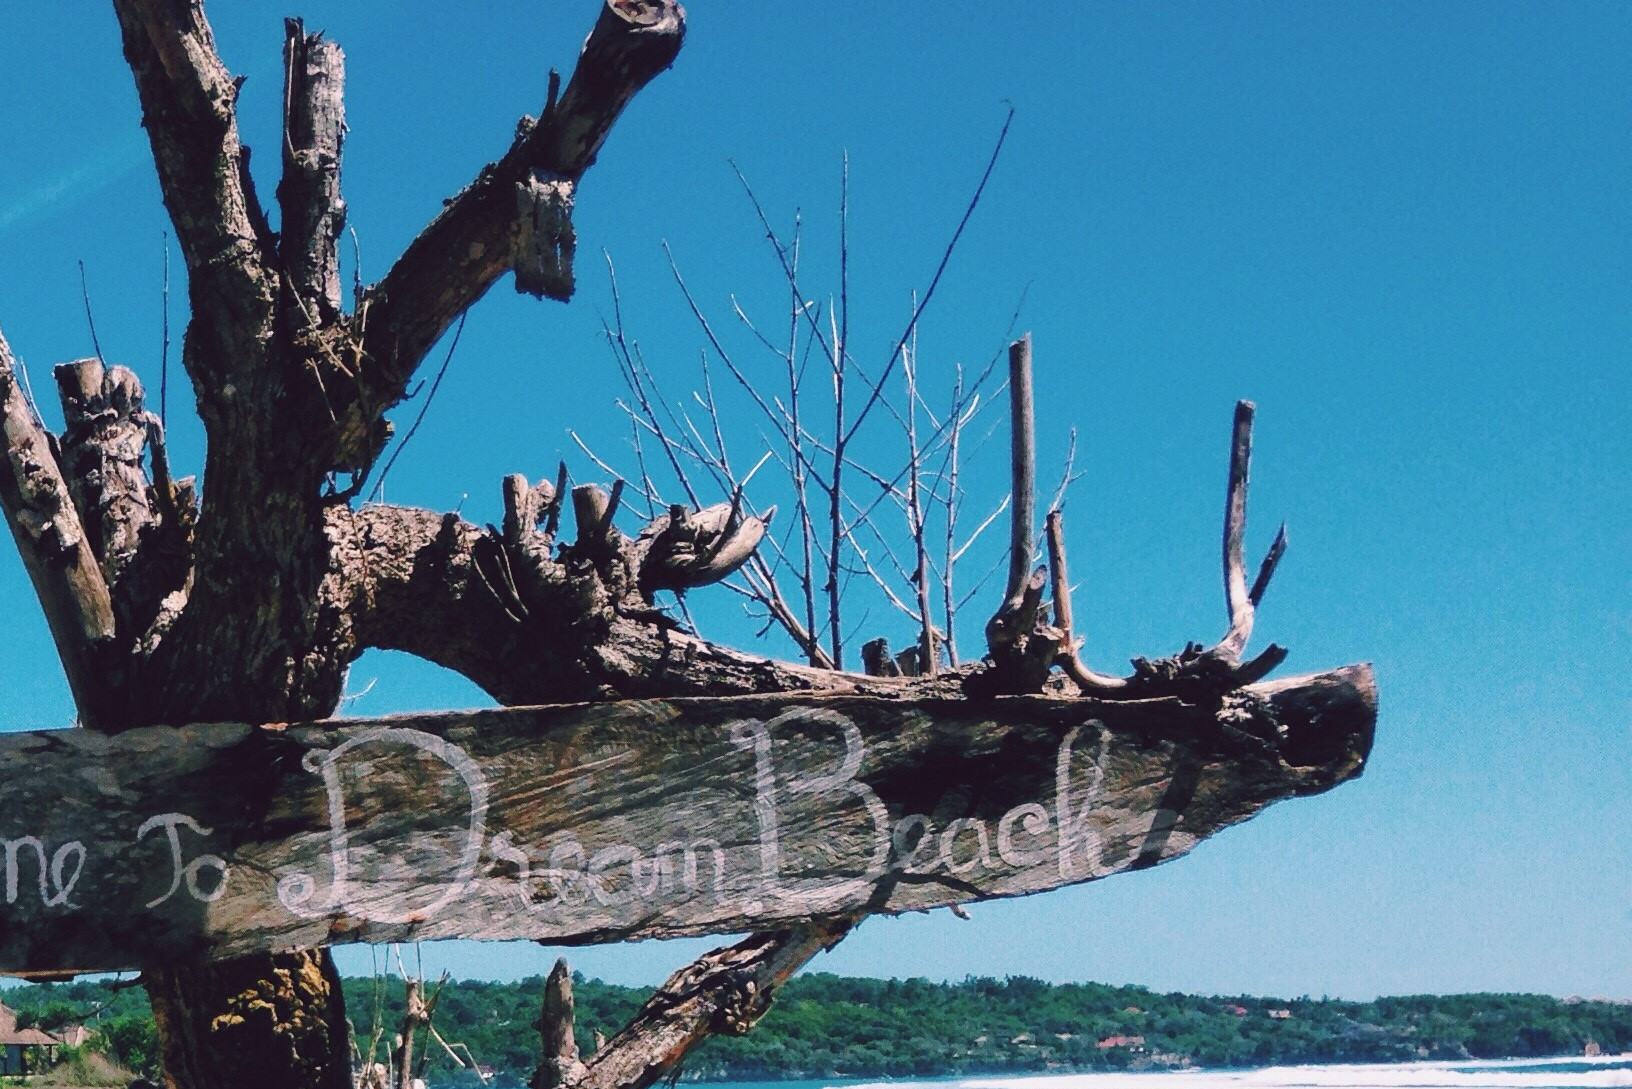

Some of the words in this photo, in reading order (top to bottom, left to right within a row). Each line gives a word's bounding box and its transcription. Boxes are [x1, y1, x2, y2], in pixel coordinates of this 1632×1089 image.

[136, 812, 231, 910] To
[277, 726, 732, 924] Dream
[729, 705, 1156, 911] Beach
